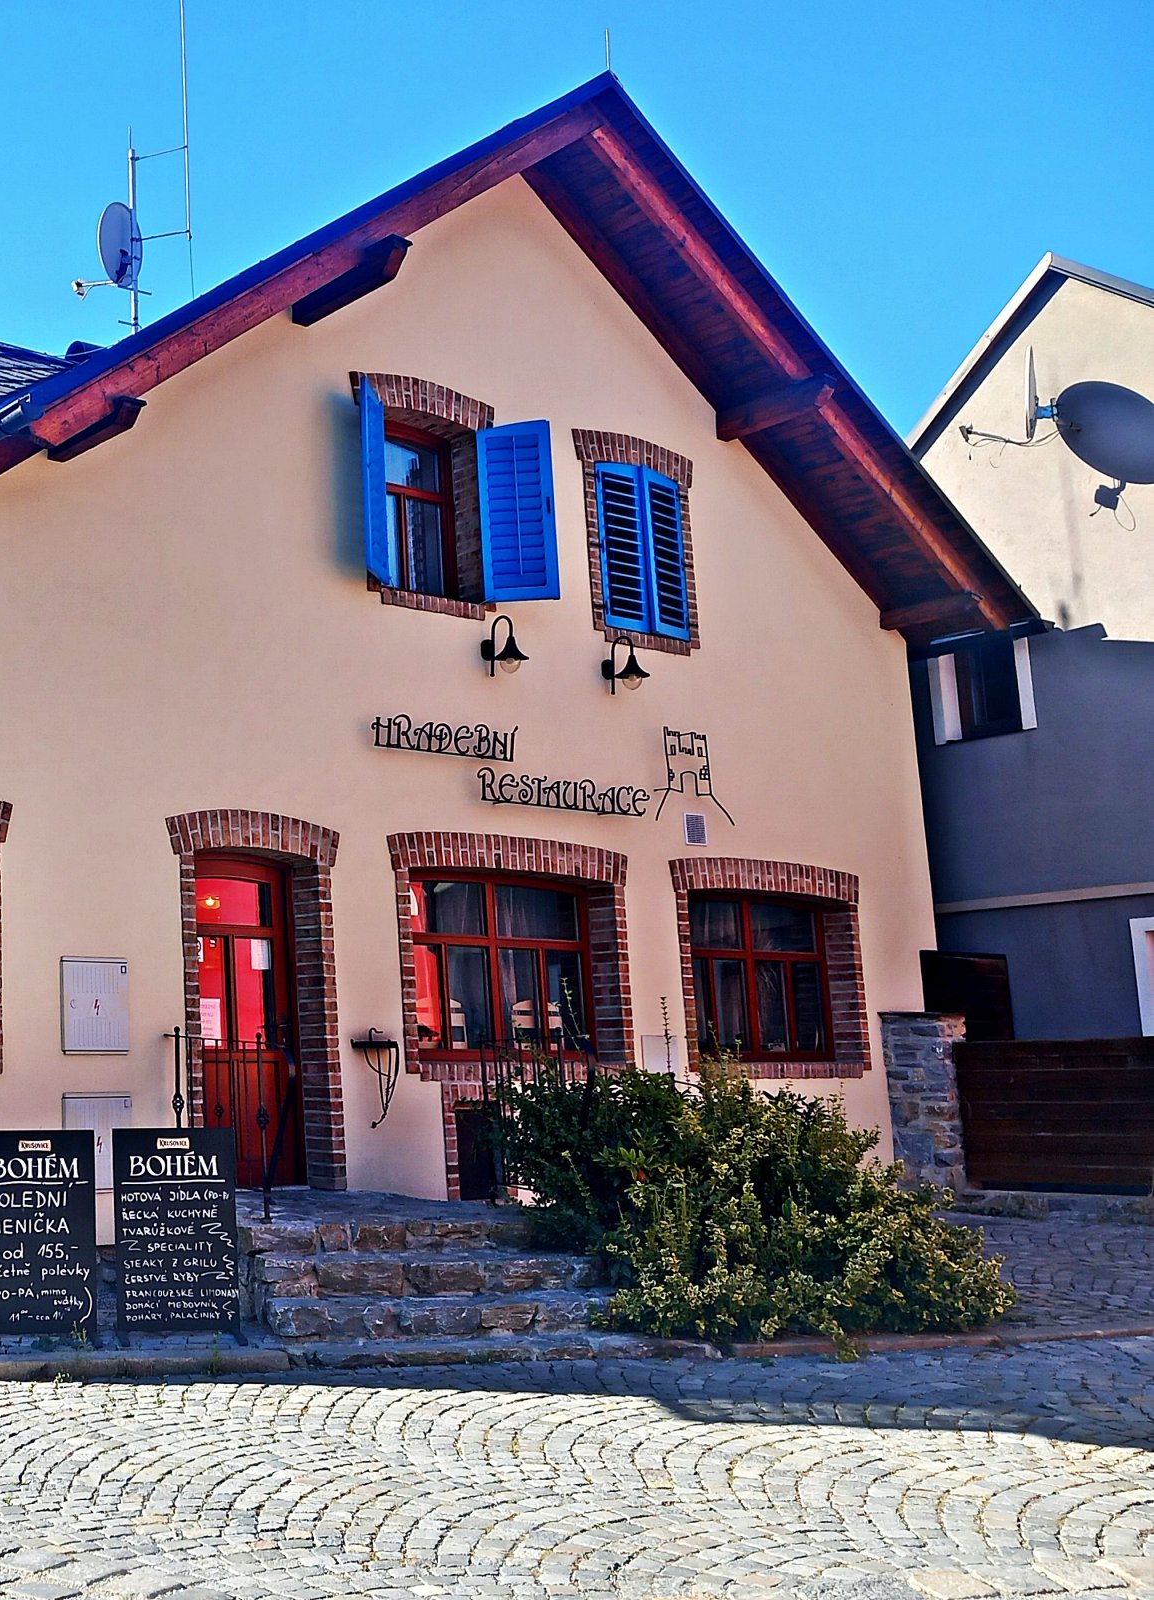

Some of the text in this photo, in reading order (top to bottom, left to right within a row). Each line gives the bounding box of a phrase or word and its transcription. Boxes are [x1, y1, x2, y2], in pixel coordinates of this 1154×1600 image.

[371, 714, 518, 761] HRADEBNÍ
[477, 767, 650, 816] RESTAURACE
[129, 1151, 219, 1177] BOHÉM
[121, 1186, 162, 1202] HOTOVÁ
[169, 1185, 201, 1201] JÍDLA
[122, 1204, 219, 1221] ŘECKÁ KUCHYNĚ
[2, 1242, 24, 1260] od
[147, 1241, 213, 1254] SPECIALITY
[41, 1262, 90, 1281] polévky
[123, 1258, 164, 1269] STEAKY
[183, 1257, 217, 1267] GRILU
[124, 1269, 199, 1284] ČERSTVÉ RYBY
[41, 1288, 67, 1296] mimo
[125, 1299, 219, 1310] DOMÁCÍ MEDOVNÍK
[170, 1309, 221, 1320] PALAČINKY
